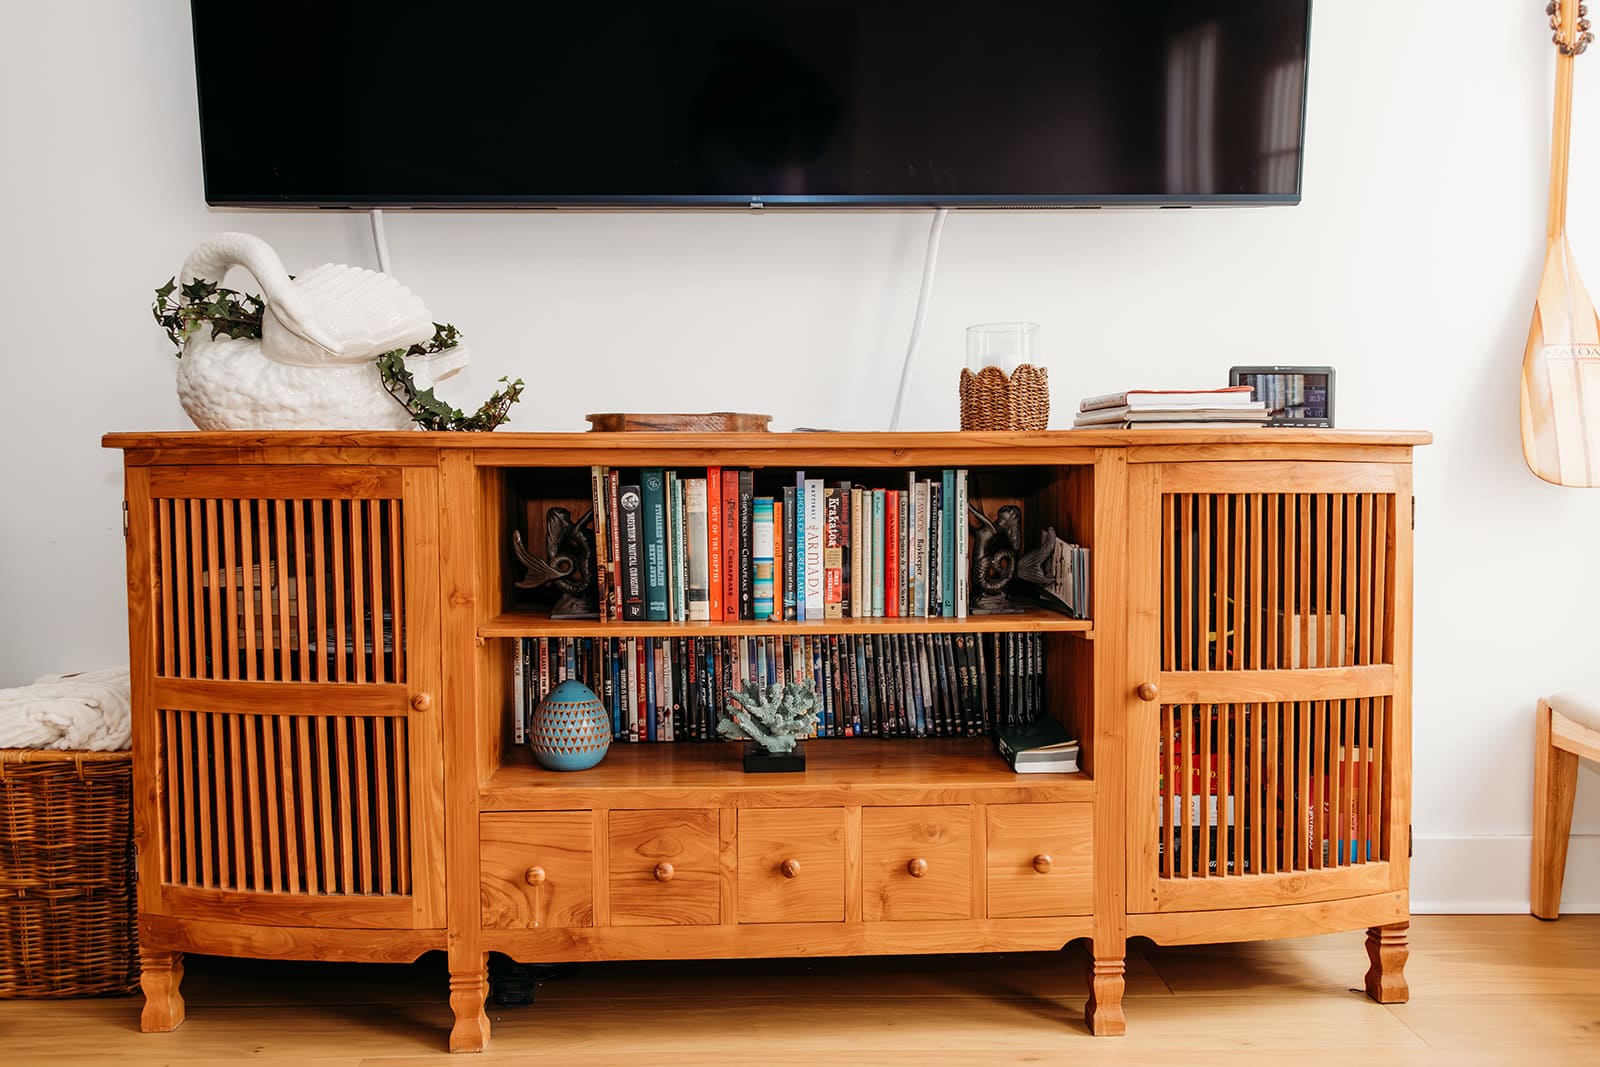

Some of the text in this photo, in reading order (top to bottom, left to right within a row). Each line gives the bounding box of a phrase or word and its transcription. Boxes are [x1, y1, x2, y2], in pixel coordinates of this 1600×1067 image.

[711, 524, 718, 534] OF
[828, 498, 840, 547] Krakatoa
[797, 491, 805, 599] GHOSTS OF THE GREAT LAKES
[808, 532, 819, 598] ARMADA
[916, 538, 925, 576] Baykeeper
[742, 548, 750, 592] CHESAPEAKE
[688, 639, 696, 683] INCEPTION
